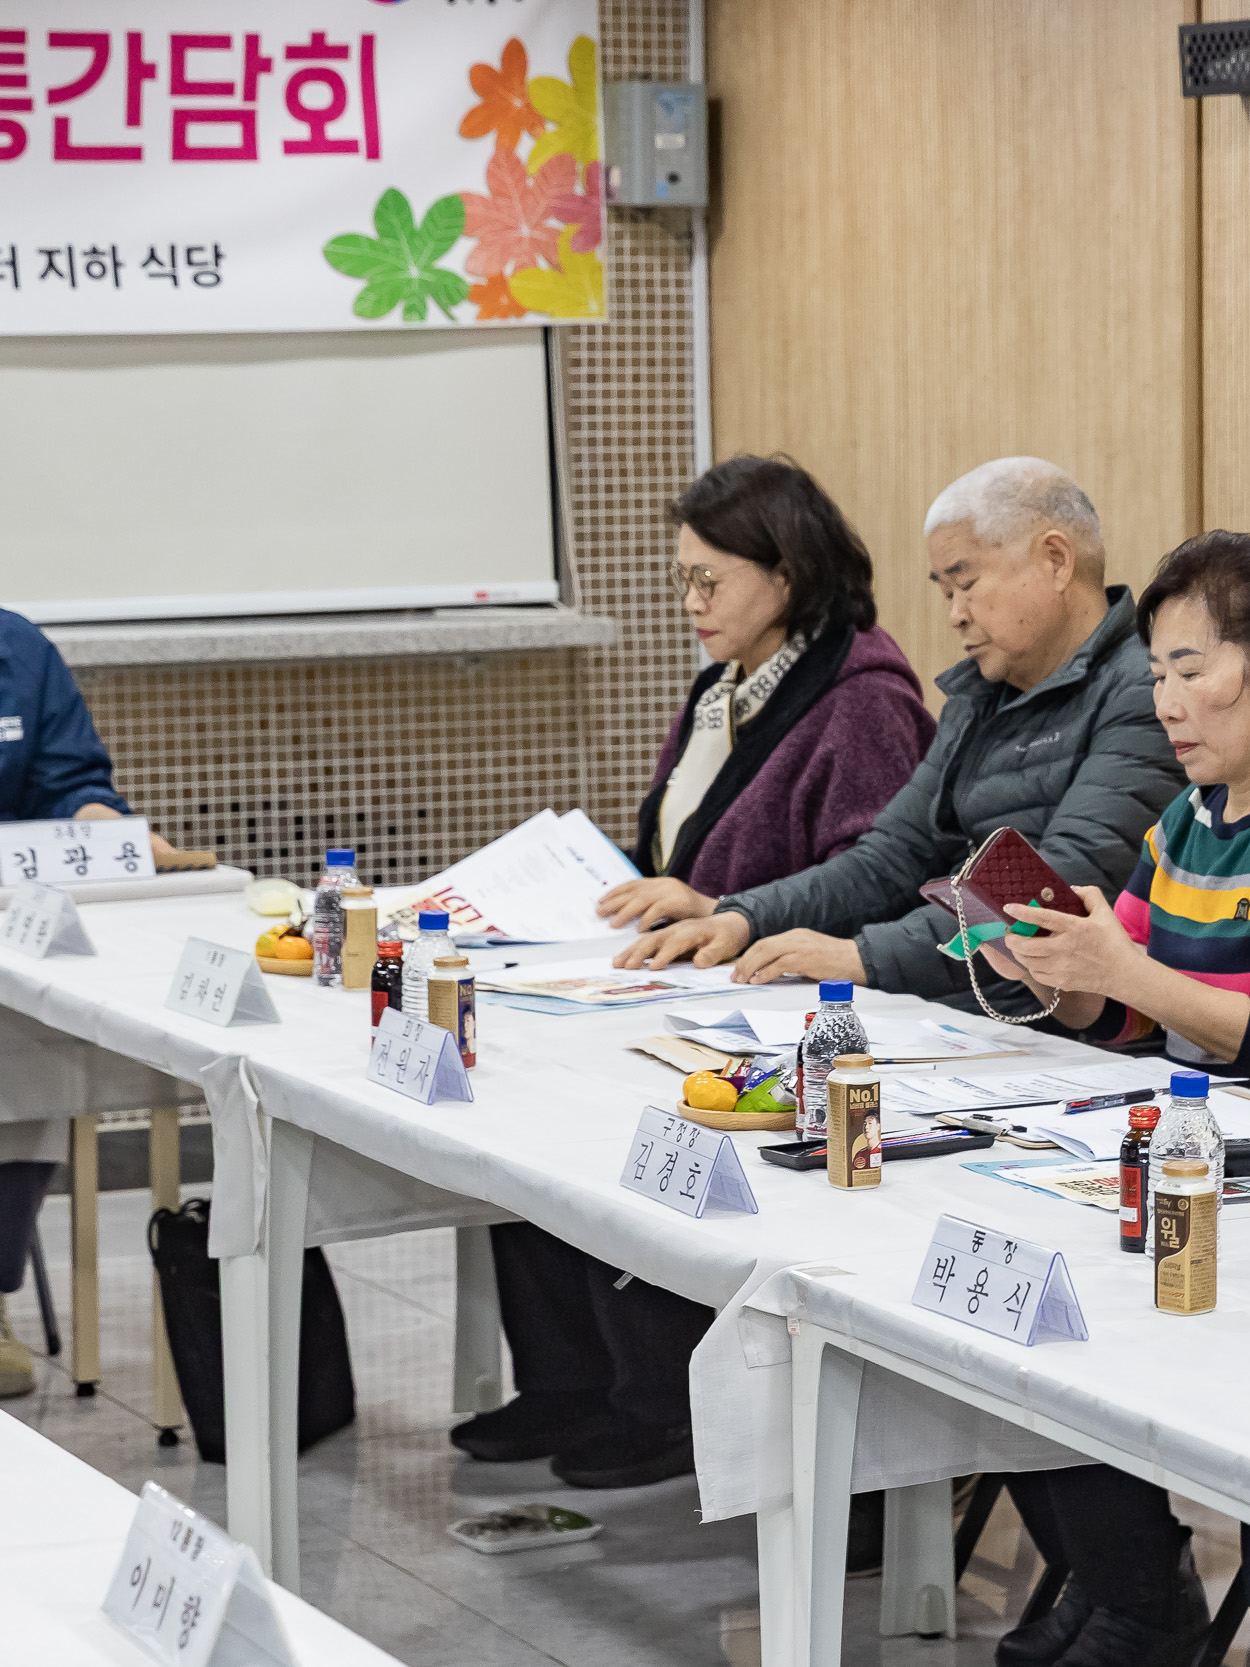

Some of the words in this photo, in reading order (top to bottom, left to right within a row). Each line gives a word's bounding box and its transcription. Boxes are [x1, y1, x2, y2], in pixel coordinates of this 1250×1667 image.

[38, 245, 124, 290] 지하
[140, 243, 225, 288] 식당
[849, 1083, 879, 1104] No.1
[661, 1116, 702, 1149] 구청장
[632, 1139, 702, 1202] 김경호
[970, 1229, 1019, 1264] 동장
[1160, 1216, 1181, 1249] 윌
[931, 1255, 1033, 1332] 박용식
